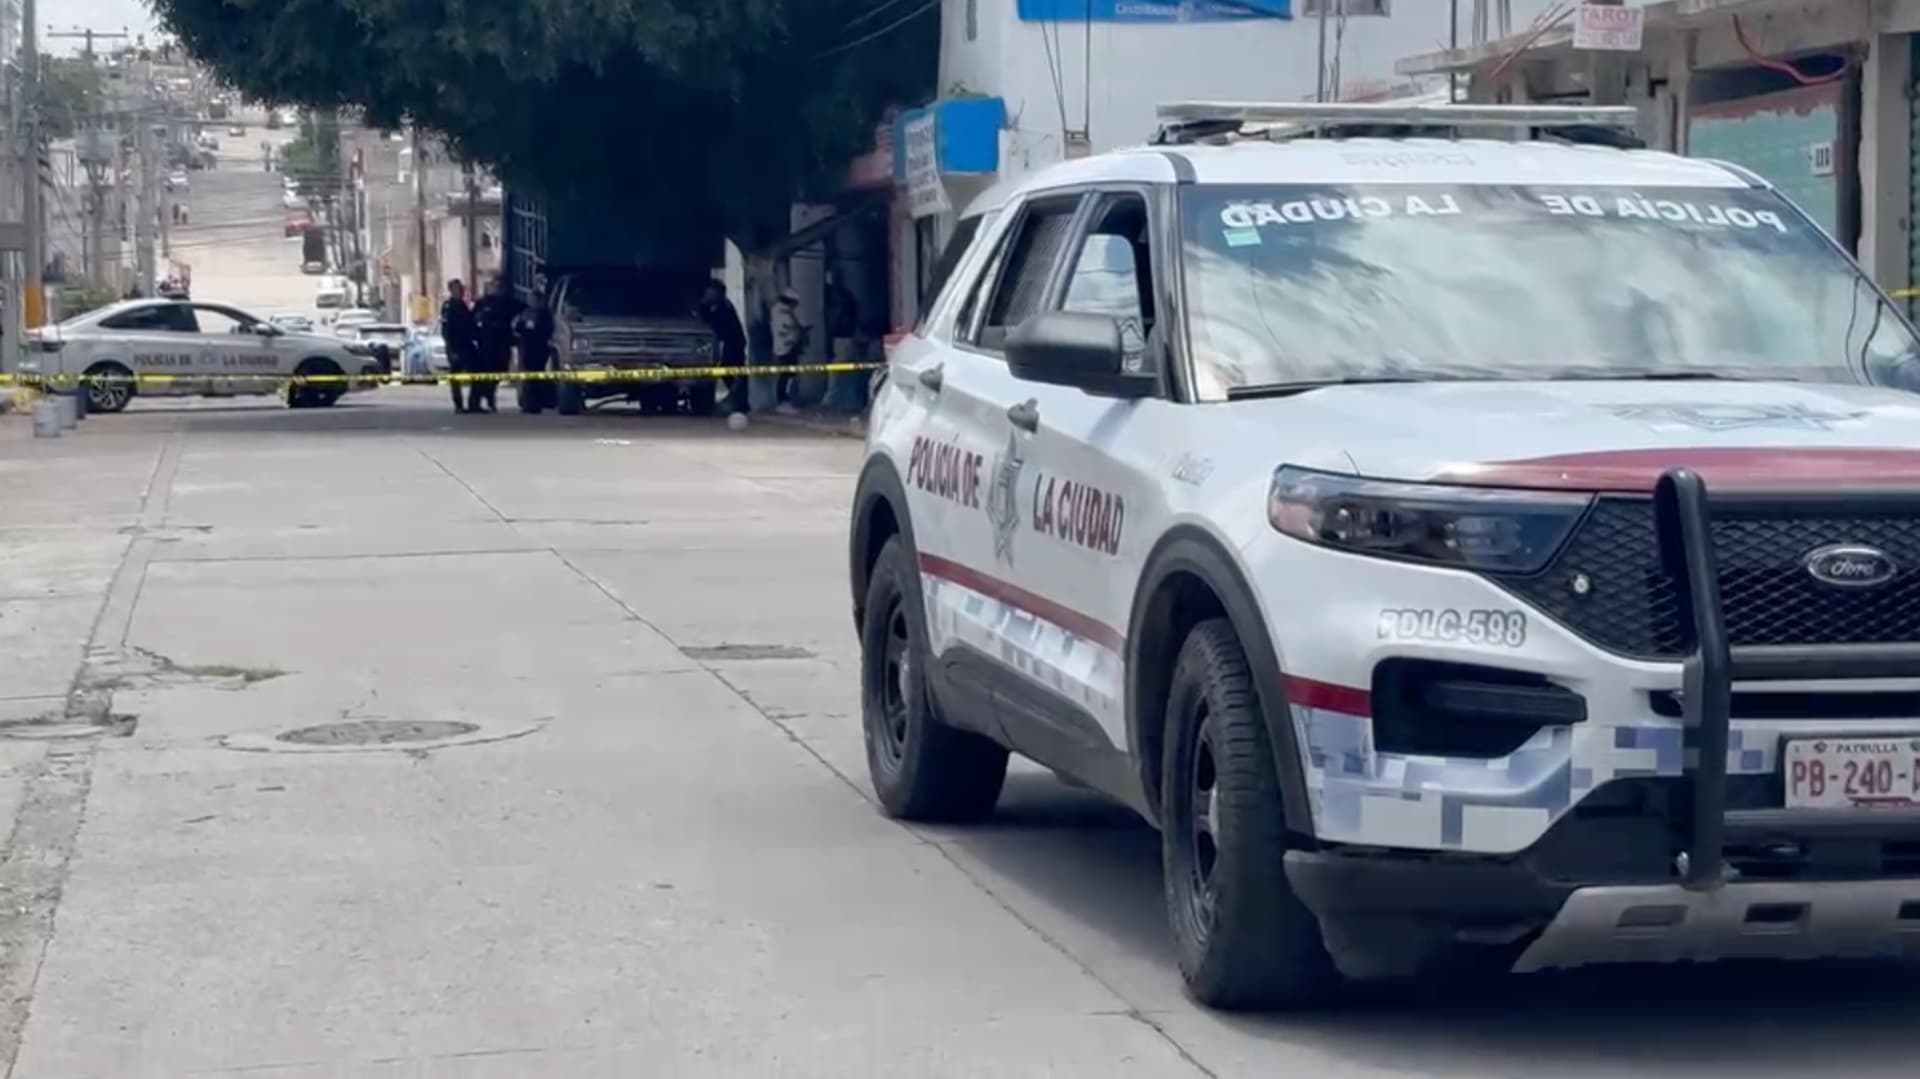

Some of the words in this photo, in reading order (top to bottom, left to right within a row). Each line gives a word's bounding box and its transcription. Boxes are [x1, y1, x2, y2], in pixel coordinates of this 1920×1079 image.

[906, 432, 961, 502] POLICÍA
[962, 448, 983, 510] DE
[1033, 473, 1056, 537] LA
[1058, 480, 1125, 556] CIUDAD
[1831, 559, 1878, 576] Ford
[1377, 608, 1527, 648] PDLC-598
[1836, 743, 1898, 753] PATRULLA
